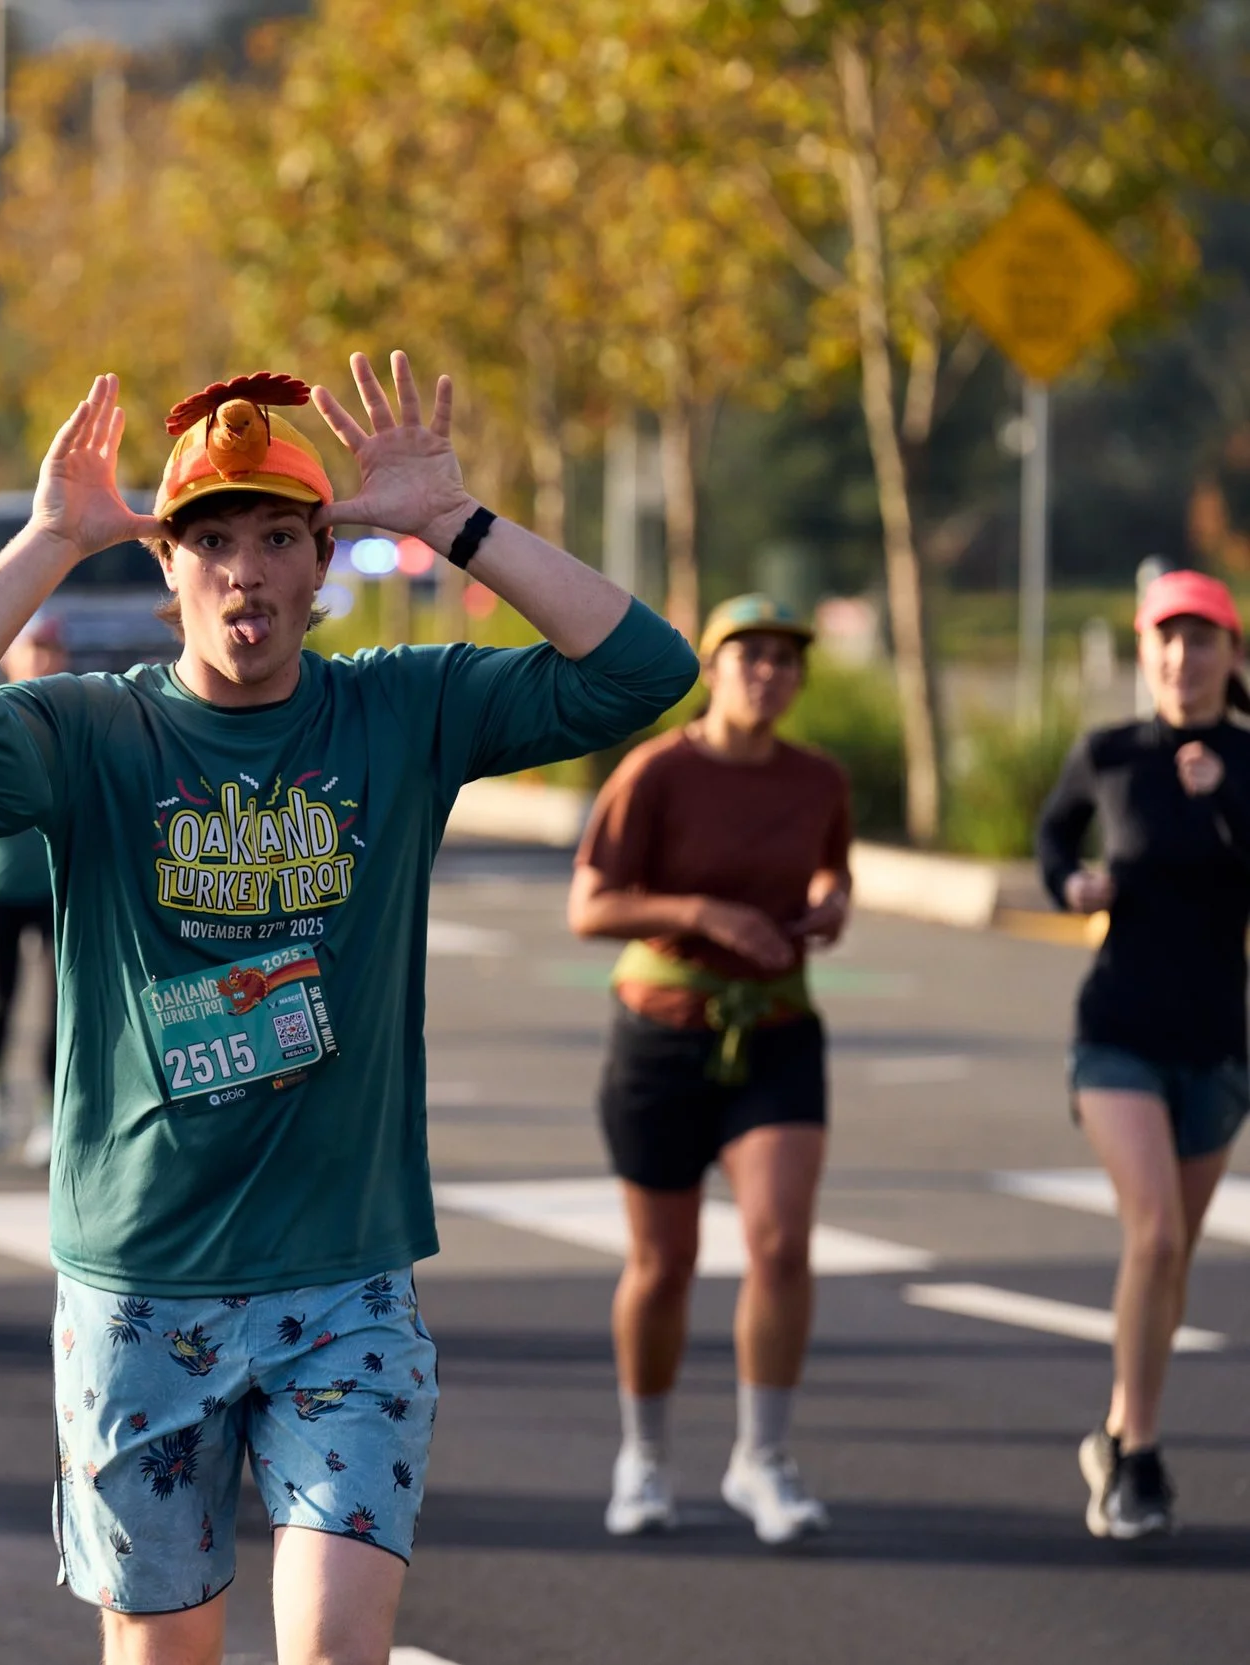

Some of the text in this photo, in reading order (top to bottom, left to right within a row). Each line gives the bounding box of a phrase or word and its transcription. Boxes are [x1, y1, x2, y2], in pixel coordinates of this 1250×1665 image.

[170, 785, 337, 865] OAKLAND
[158, 857, 351, 911] TURKEY TROT
[180, 917, 324, 940] NOVEMBER 27TH 2025
[262, 948, 300, 972] 2025
[151, 975, 221, 1013] OAKLAND
[279, 993, 302, 1005] MASCOT
[156, 996, 225, 1030] TURKEY TROT
[309, 985, 337, 1053] 5K RUN/WALK
[164, 1031, 256, 1091] 2515
[285, 1046, 314, 1059] RESULTS
[220, 1088, 246, 1102] abio
